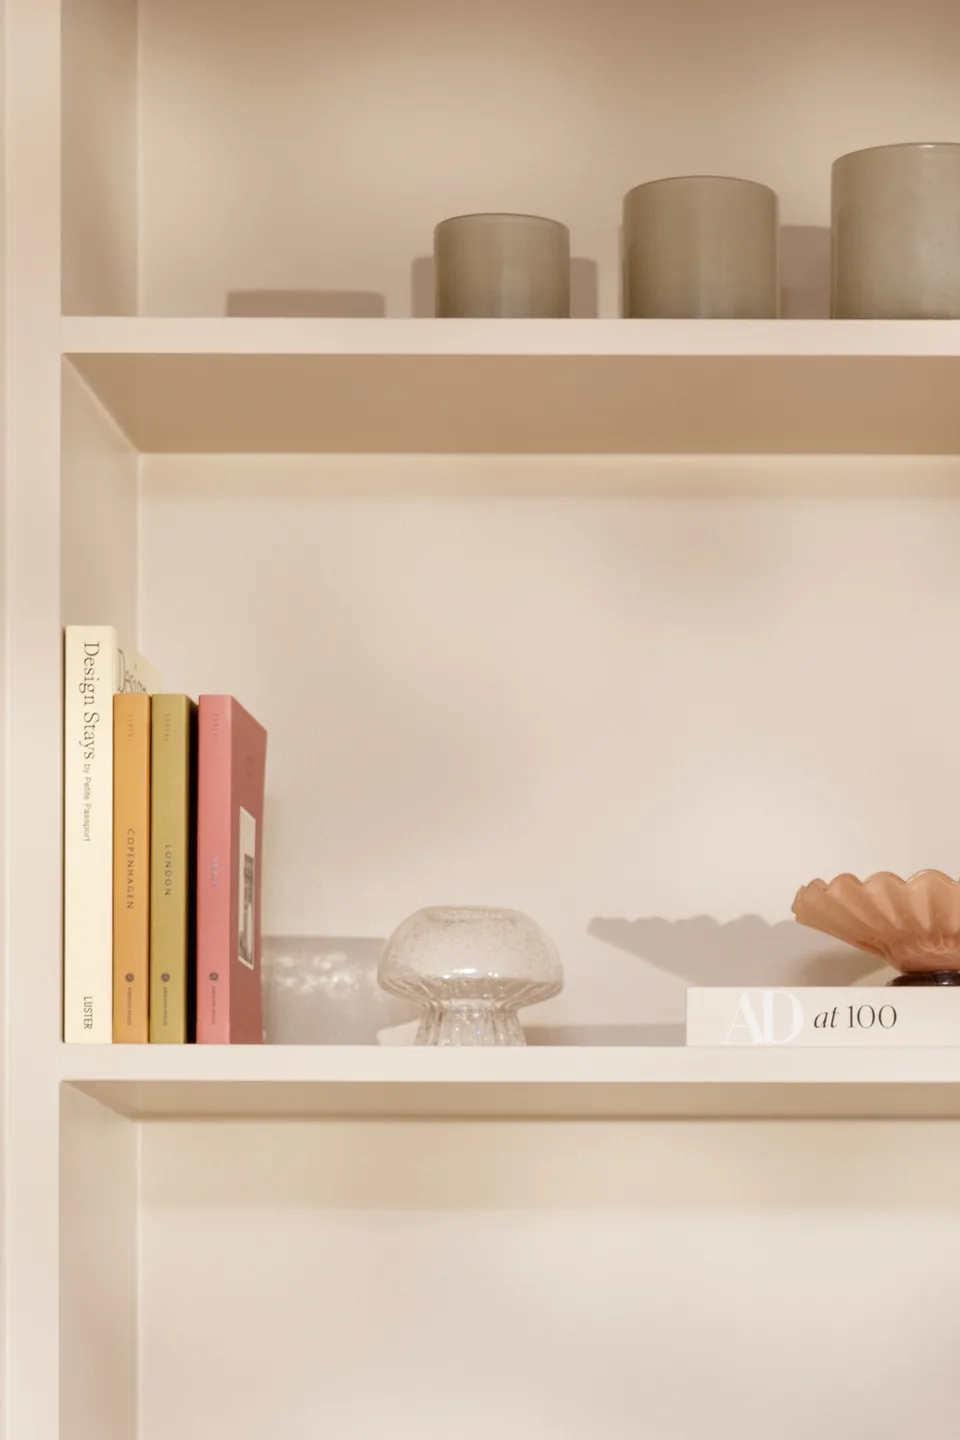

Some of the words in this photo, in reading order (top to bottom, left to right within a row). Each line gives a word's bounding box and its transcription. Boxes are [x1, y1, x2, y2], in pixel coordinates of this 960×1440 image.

[78, 641, 100, 706] Design
[78, 711, 100, 760] Stays
[82, 763, 92, 774] by
[83, 776, 92, 801] Petite
[81, 802, 92, 842] Passport
[126, 828, 135, 909] COPENHAGEN
[164, 844, 172, 896] LONDON
[83, 996, 94, 1030] LUSTER
[720, 989, 804, 1045] AD
[813, 1006, 840, 1029] at
[847, 1004, 898, 1029] 100
